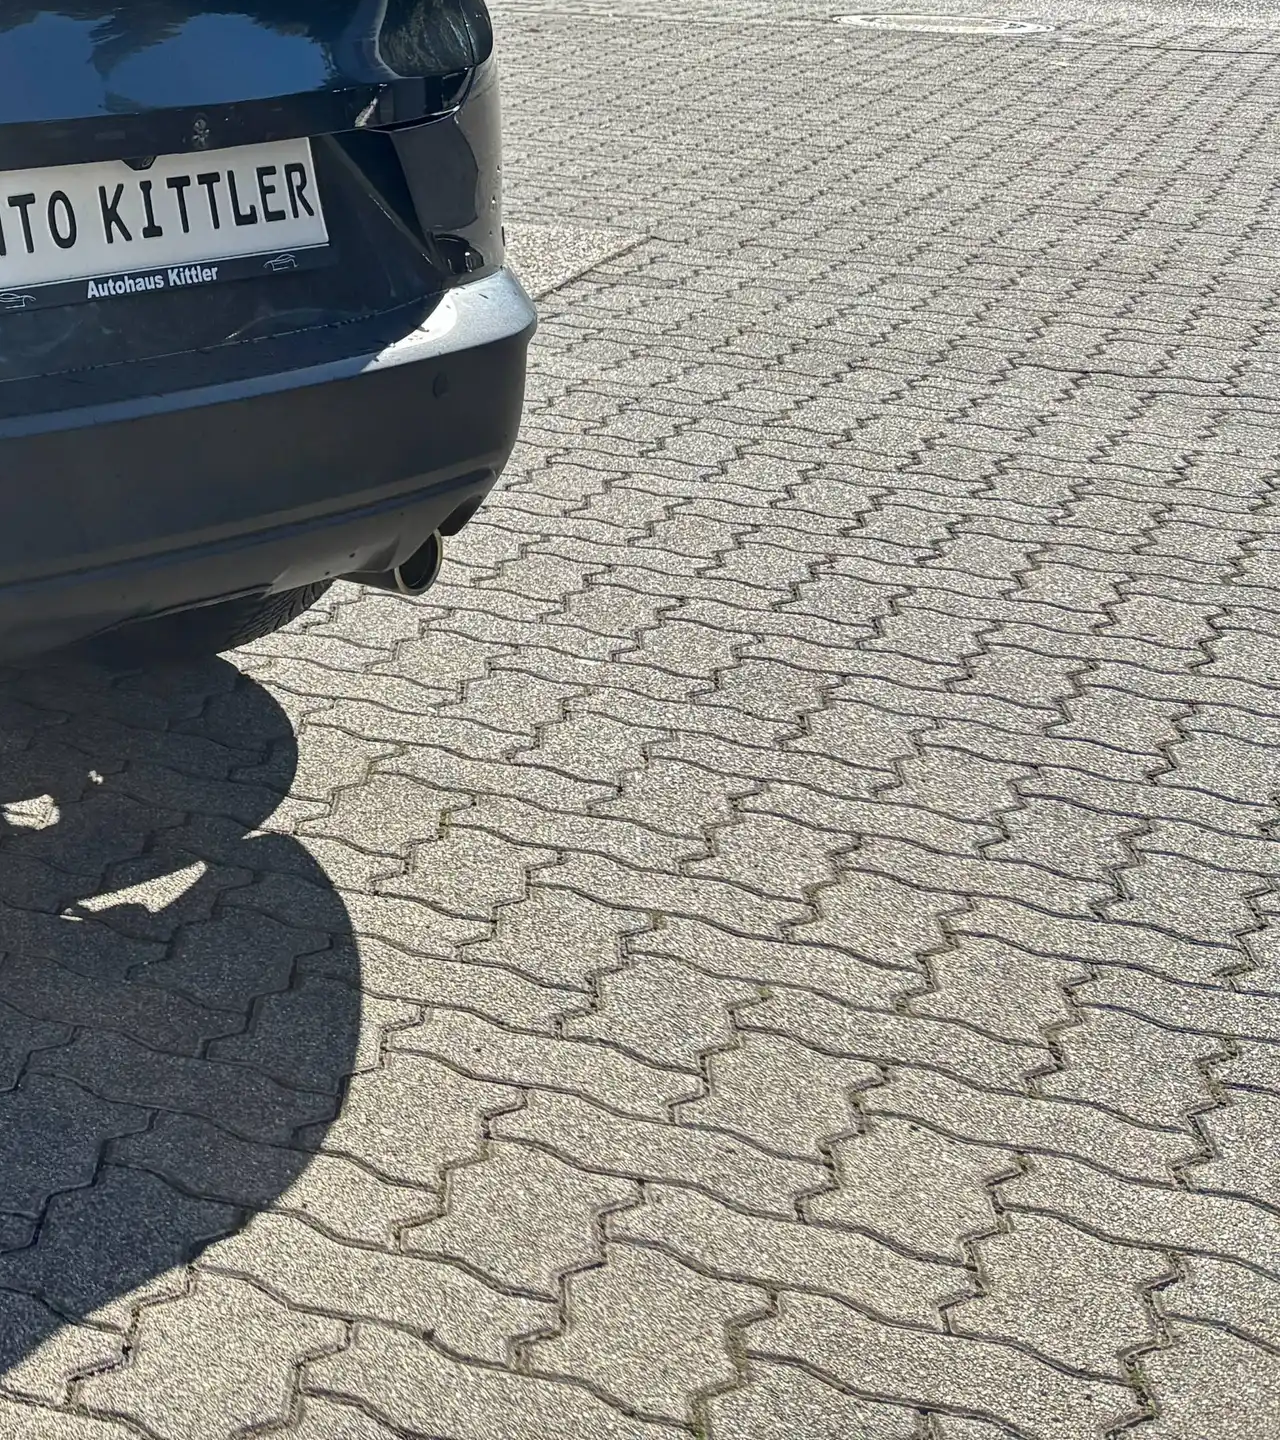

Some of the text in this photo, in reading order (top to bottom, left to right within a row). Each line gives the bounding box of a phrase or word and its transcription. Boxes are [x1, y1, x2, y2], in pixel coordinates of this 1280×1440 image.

[98, 161, 316, 244] KITTLER
[87, 264, 218, 299] Autohaus Kittler
